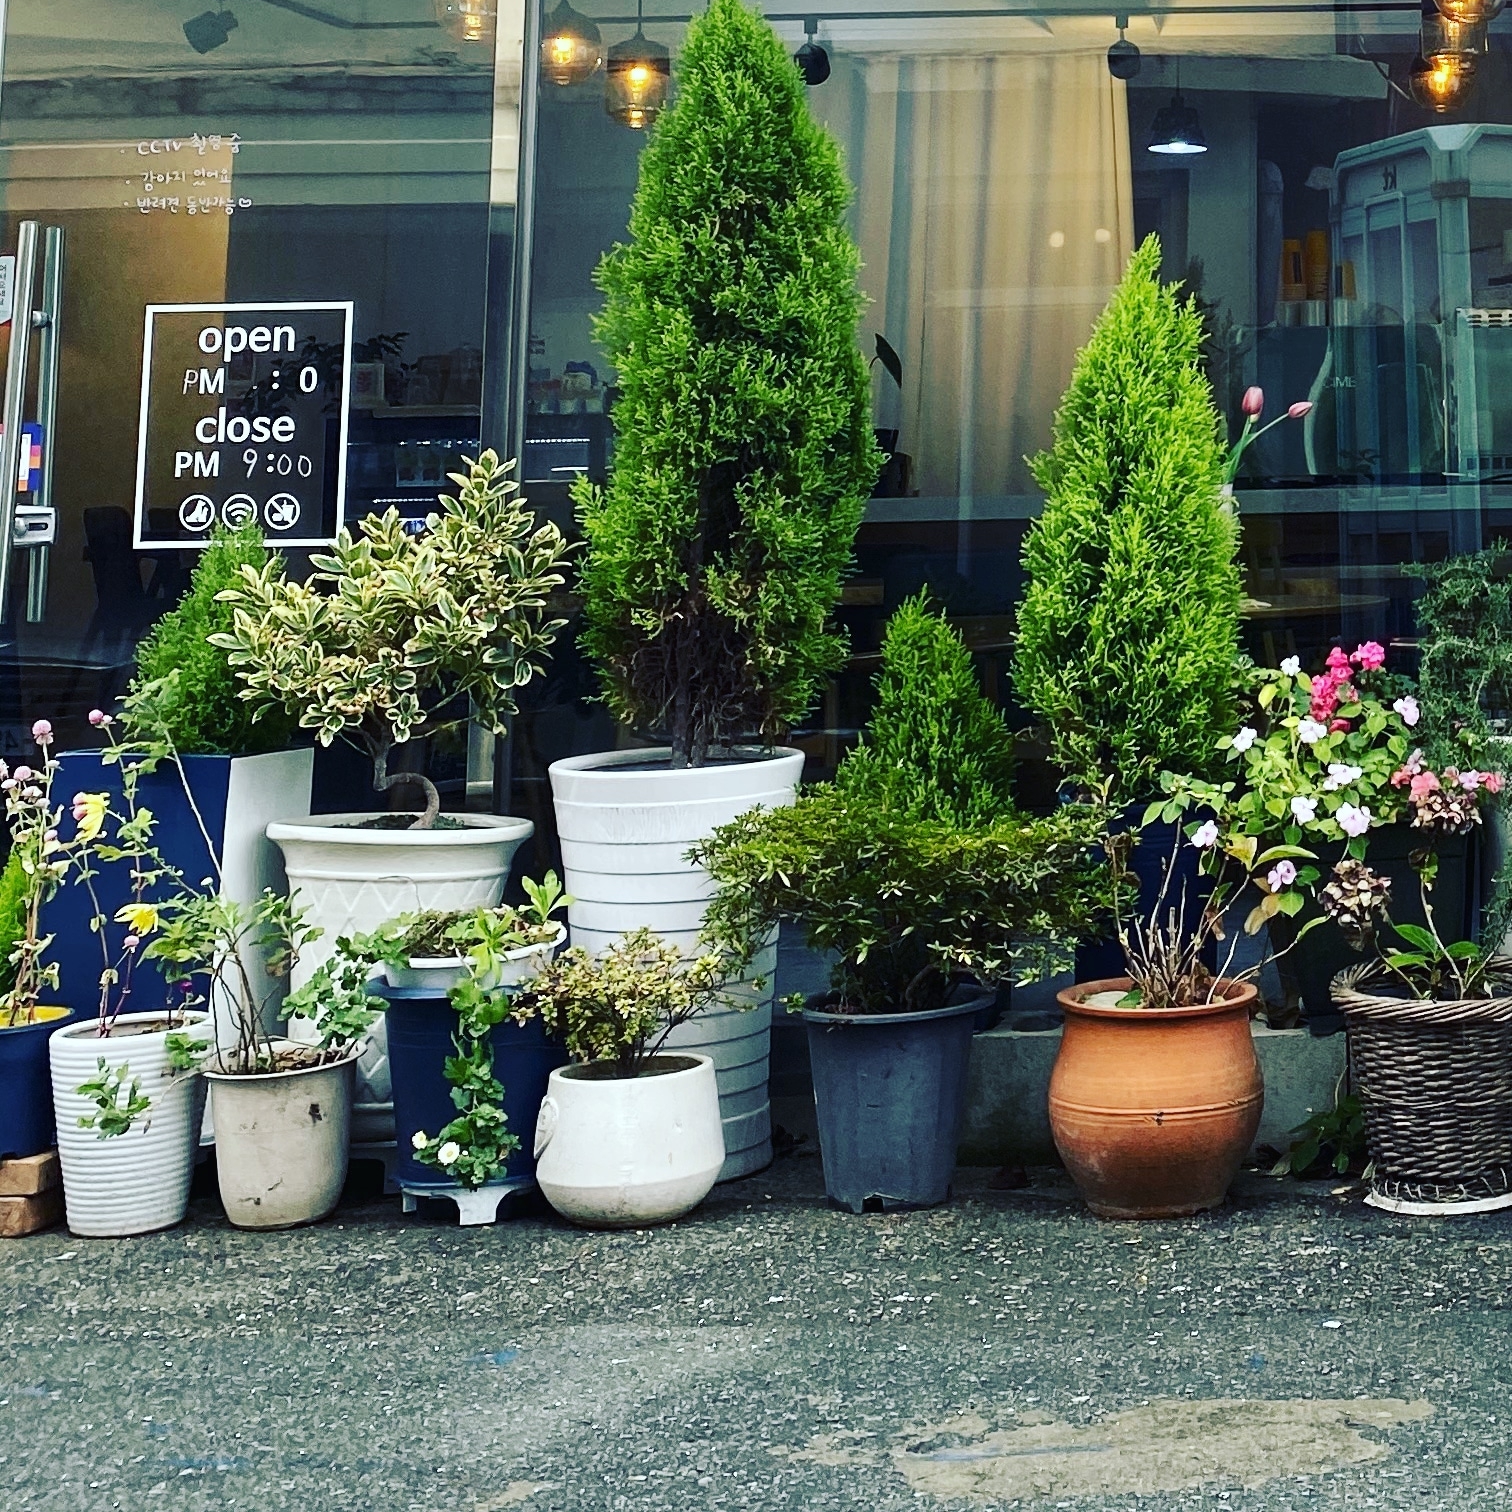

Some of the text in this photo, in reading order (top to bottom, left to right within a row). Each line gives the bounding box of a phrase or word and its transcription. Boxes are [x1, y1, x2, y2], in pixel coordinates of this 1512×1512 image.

[140, 167, 232, 192] 강아지 있어요
[198, 324, 296, 363] open
[182, 367, 226, 395] PM
[195, 406, 296, 444] close
[174, 448, 313, 479] PM 9:00
